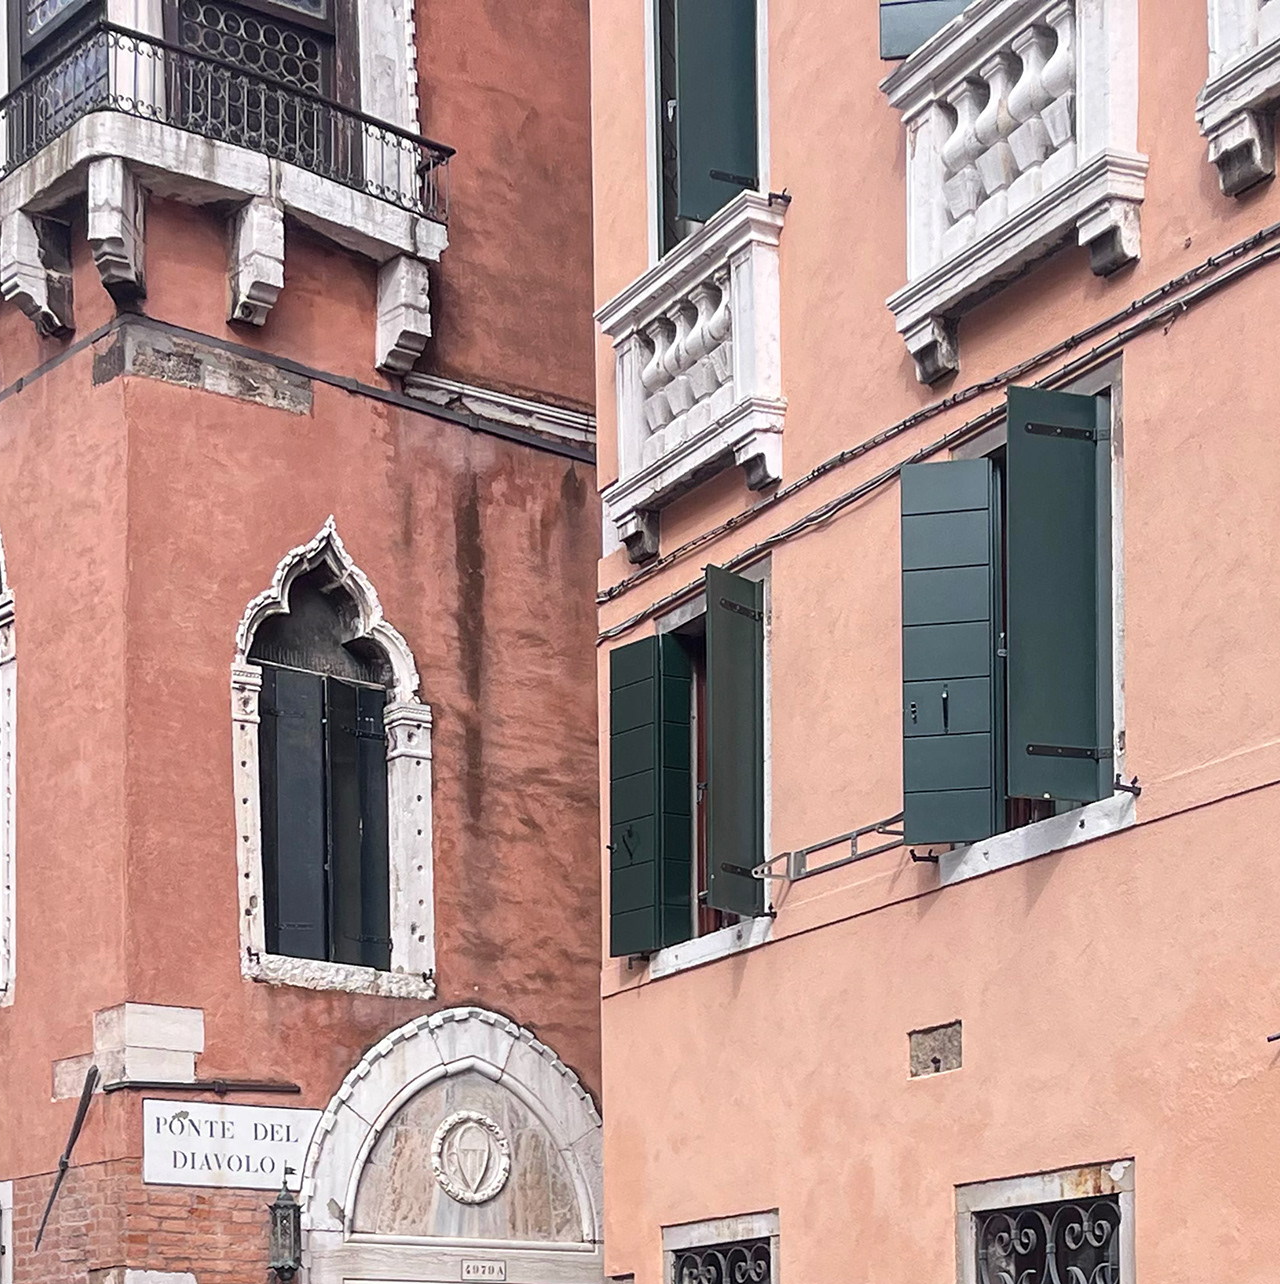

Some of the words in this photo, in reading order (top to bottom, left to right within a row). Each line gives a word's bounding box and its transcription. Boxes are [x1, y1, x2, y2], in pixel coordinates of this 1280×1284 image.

[155, 1116, 235, 1139] PONTE
[253, 1122, 299, 1143] DEL
[172, 1150, 276, 1174] DIAVOLO
